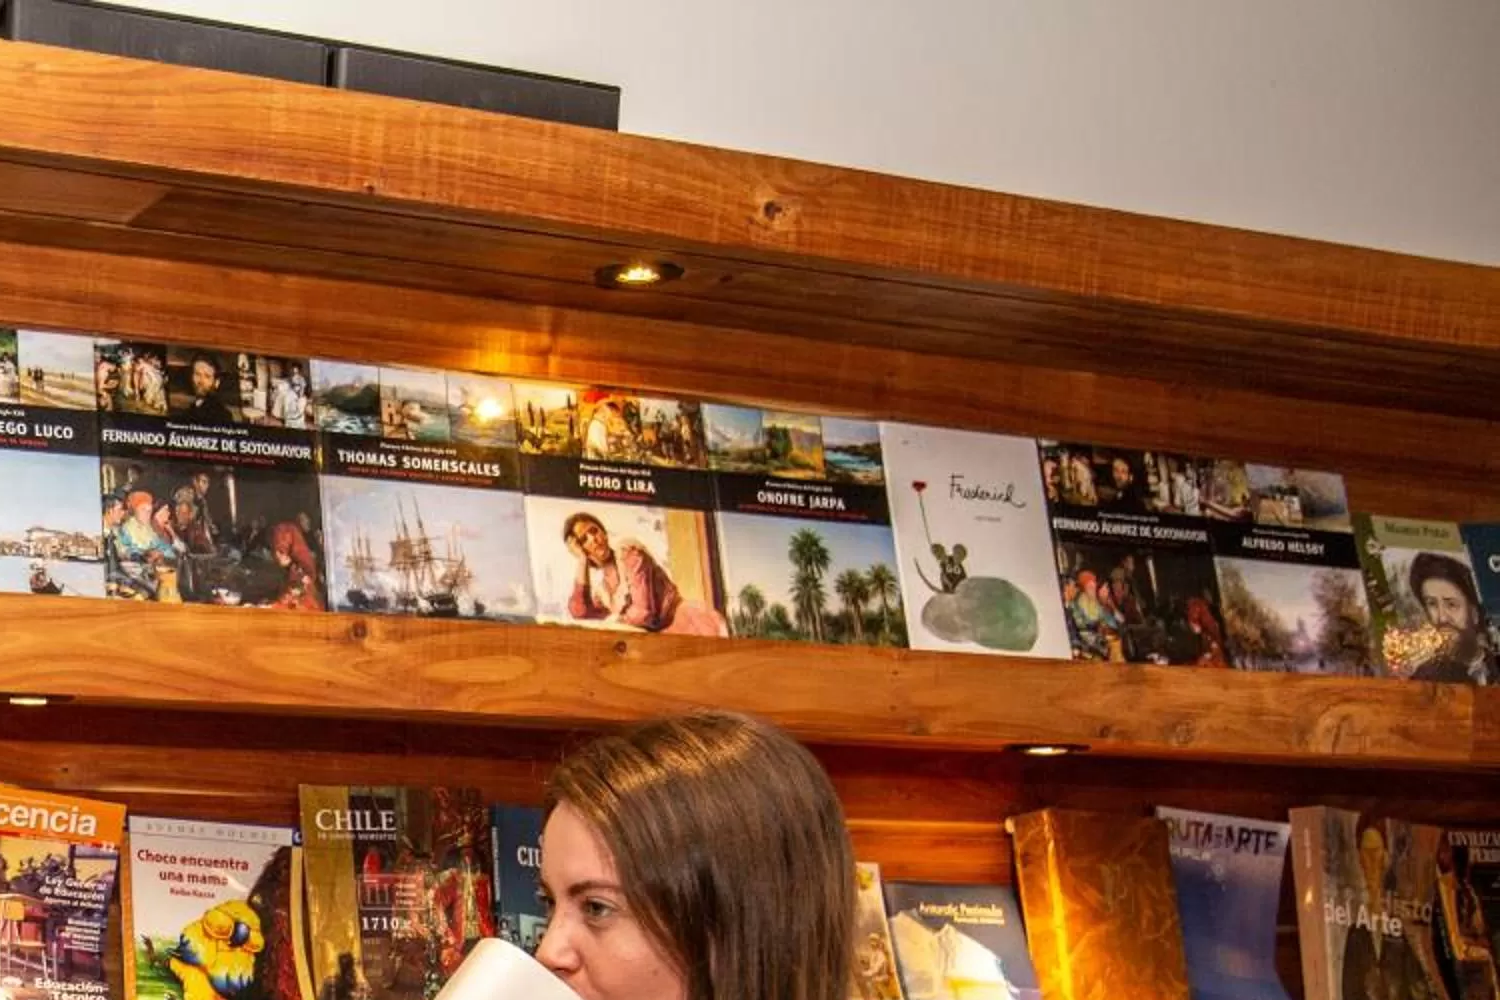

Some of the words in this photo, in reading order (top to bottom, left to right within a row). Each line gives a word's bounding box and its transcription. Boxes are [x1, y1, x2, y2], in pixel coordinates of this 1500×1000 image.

[35, 424, 74, 440] LUCO
[102, 429, 165, 446] FERNANDO
[168, 431, 218, 451] ÁLVAREZ
[221, 440, 237, 453] DE
[239, 440, 312, 460] SOTOMAYOR
[337, 449, 397, 467] THOMAS
[402, 456, 501, 477] SOMERSCALES
[579, 475, 621, 490] PEDRO
[625, 479, 656, 494] LIRA
[757, 491, 805, 507] ONOFRE
[809, 495, 846, 511] JARPA
[1052, 517, 1099, 533] FERNANDO
[1139, 525, 1152, 538] DE
[1242, 536, 1285, 551] ALFREDO
[315, 809, 397, 831] CHILE
[1225, 825, 1278, 855] ARTE
[137, 849, 177, 865] Choco
[180, 856, 249, 872] encuentra
[45, 875, 63, 887] Ley
[159, 870, 184, 882] una
[39, 886, 52, 894] de
[361, 916, 399, 931] 1710
[1356, 904, 1402, 937] Arte
